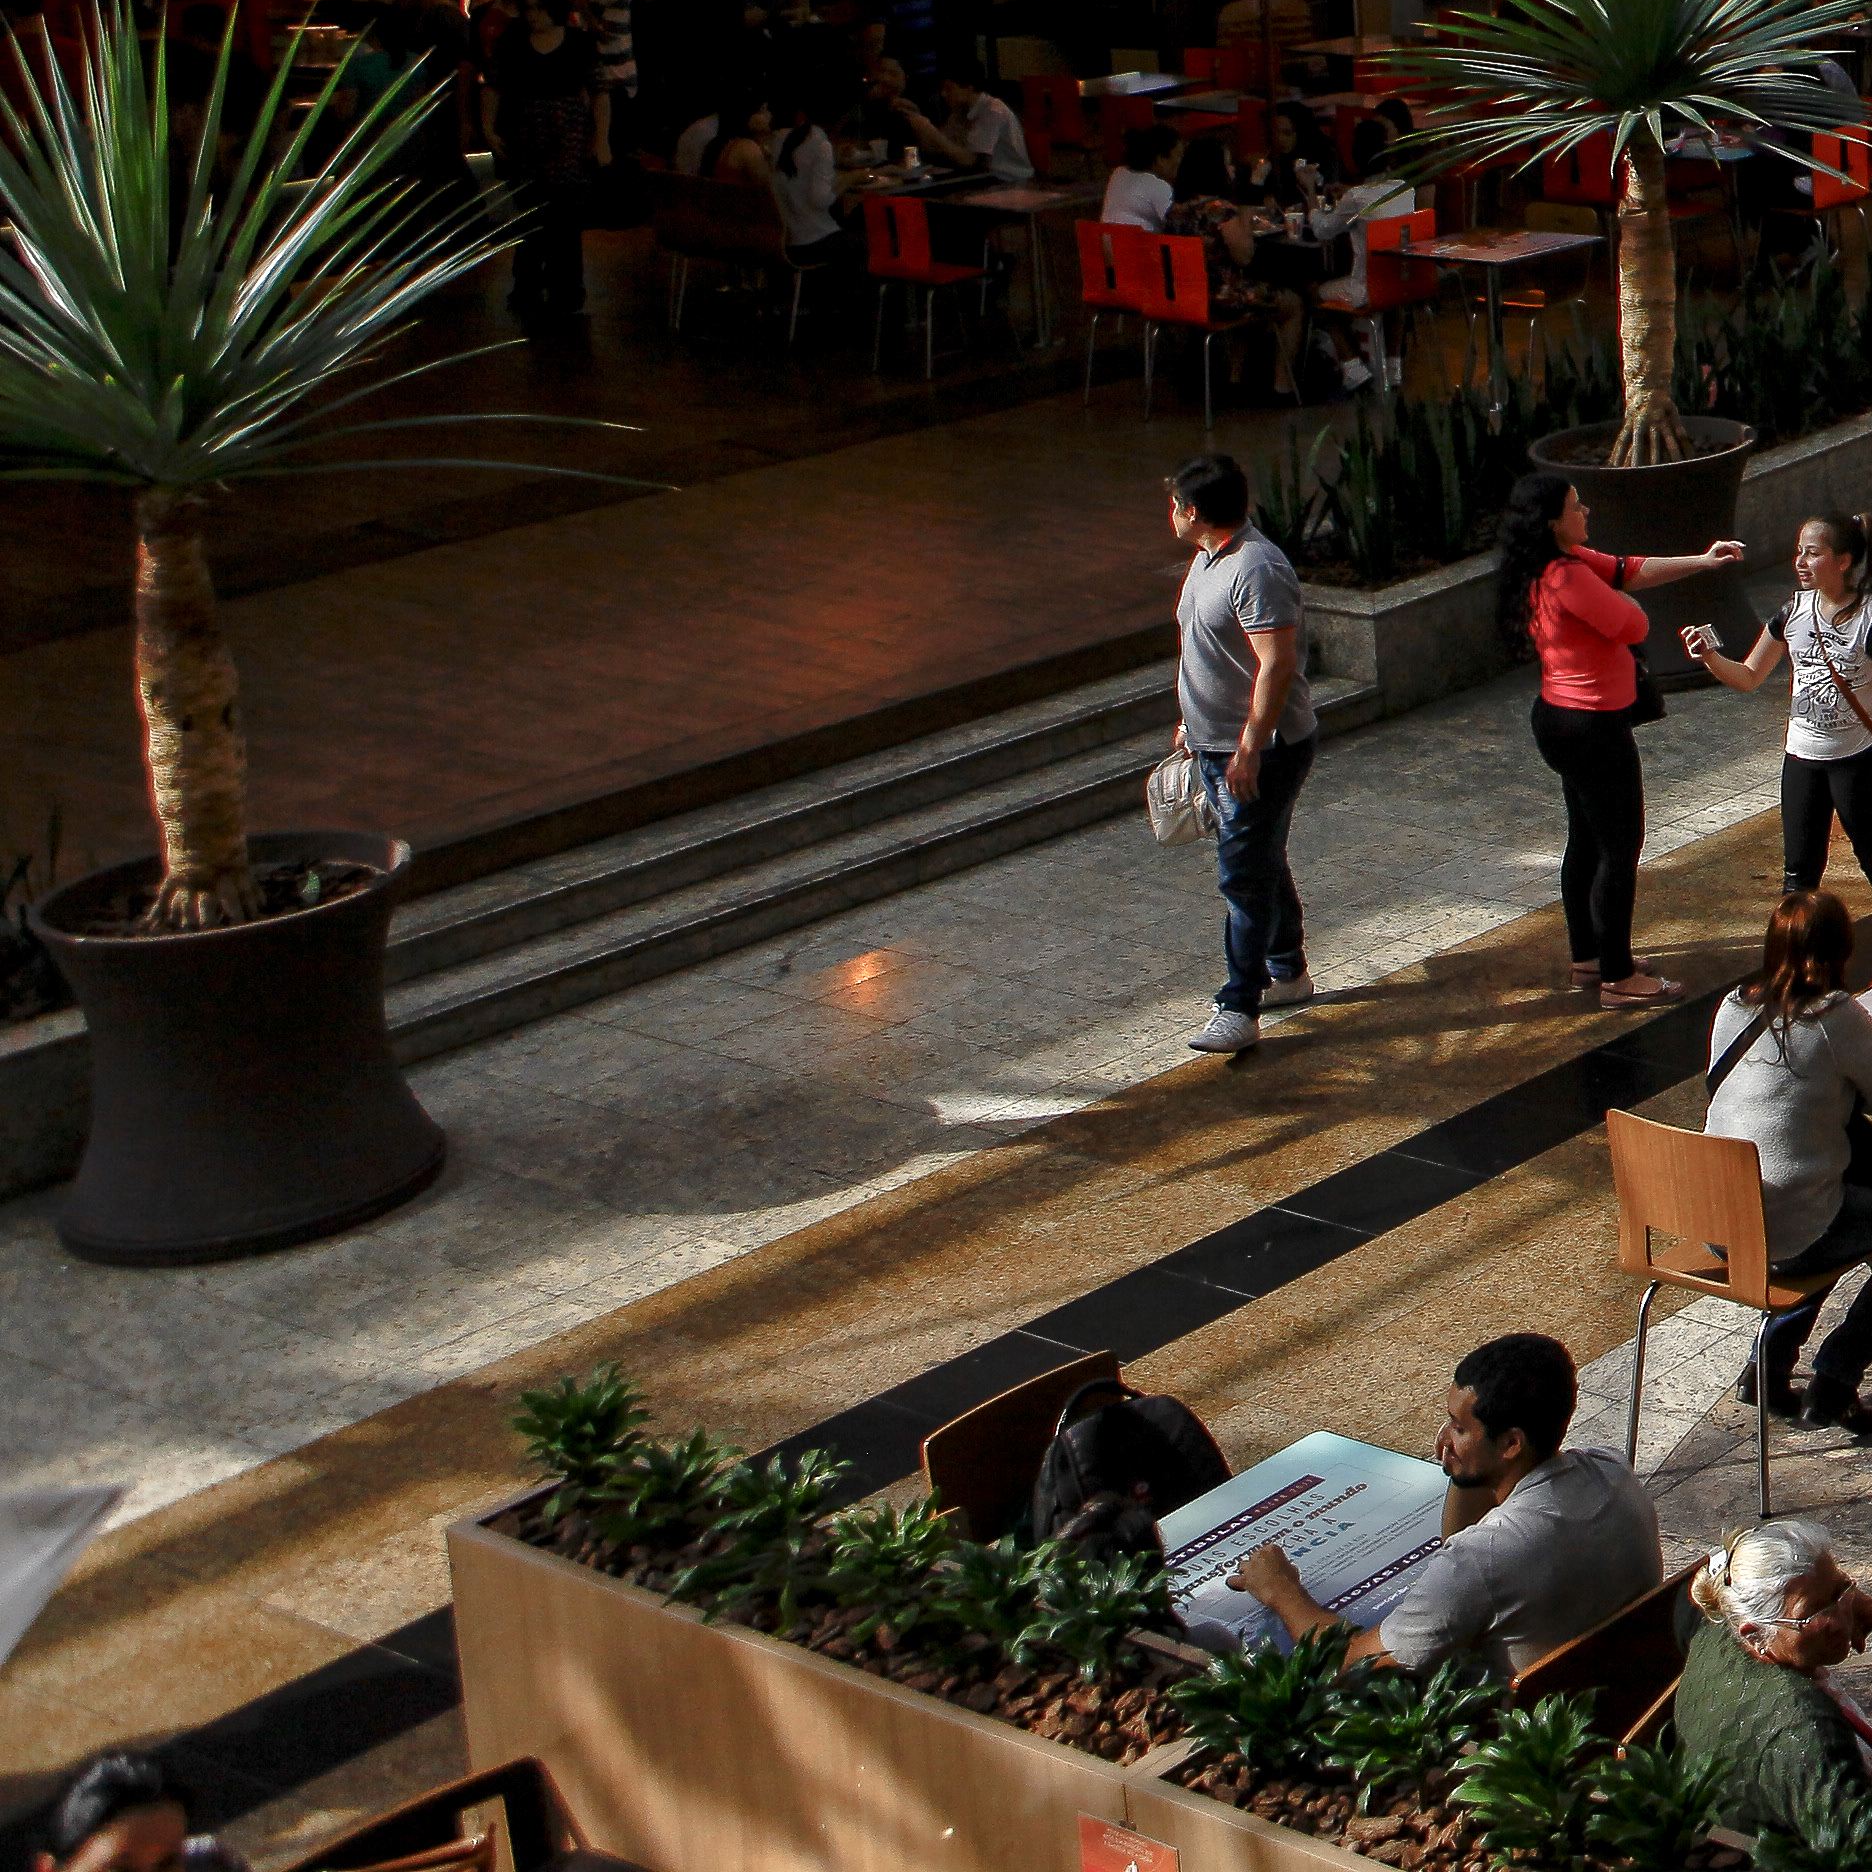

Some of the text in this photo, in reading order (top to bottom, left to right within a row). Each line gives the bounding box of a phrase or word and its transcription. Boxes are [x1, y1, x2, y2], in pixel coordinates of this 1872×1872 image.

[1164, 1513, 1253, 1566] STIBULAR
[1174, 1525, 1293, 1596] ansformam
[1303, 1481, 1368, 1519] mundo
